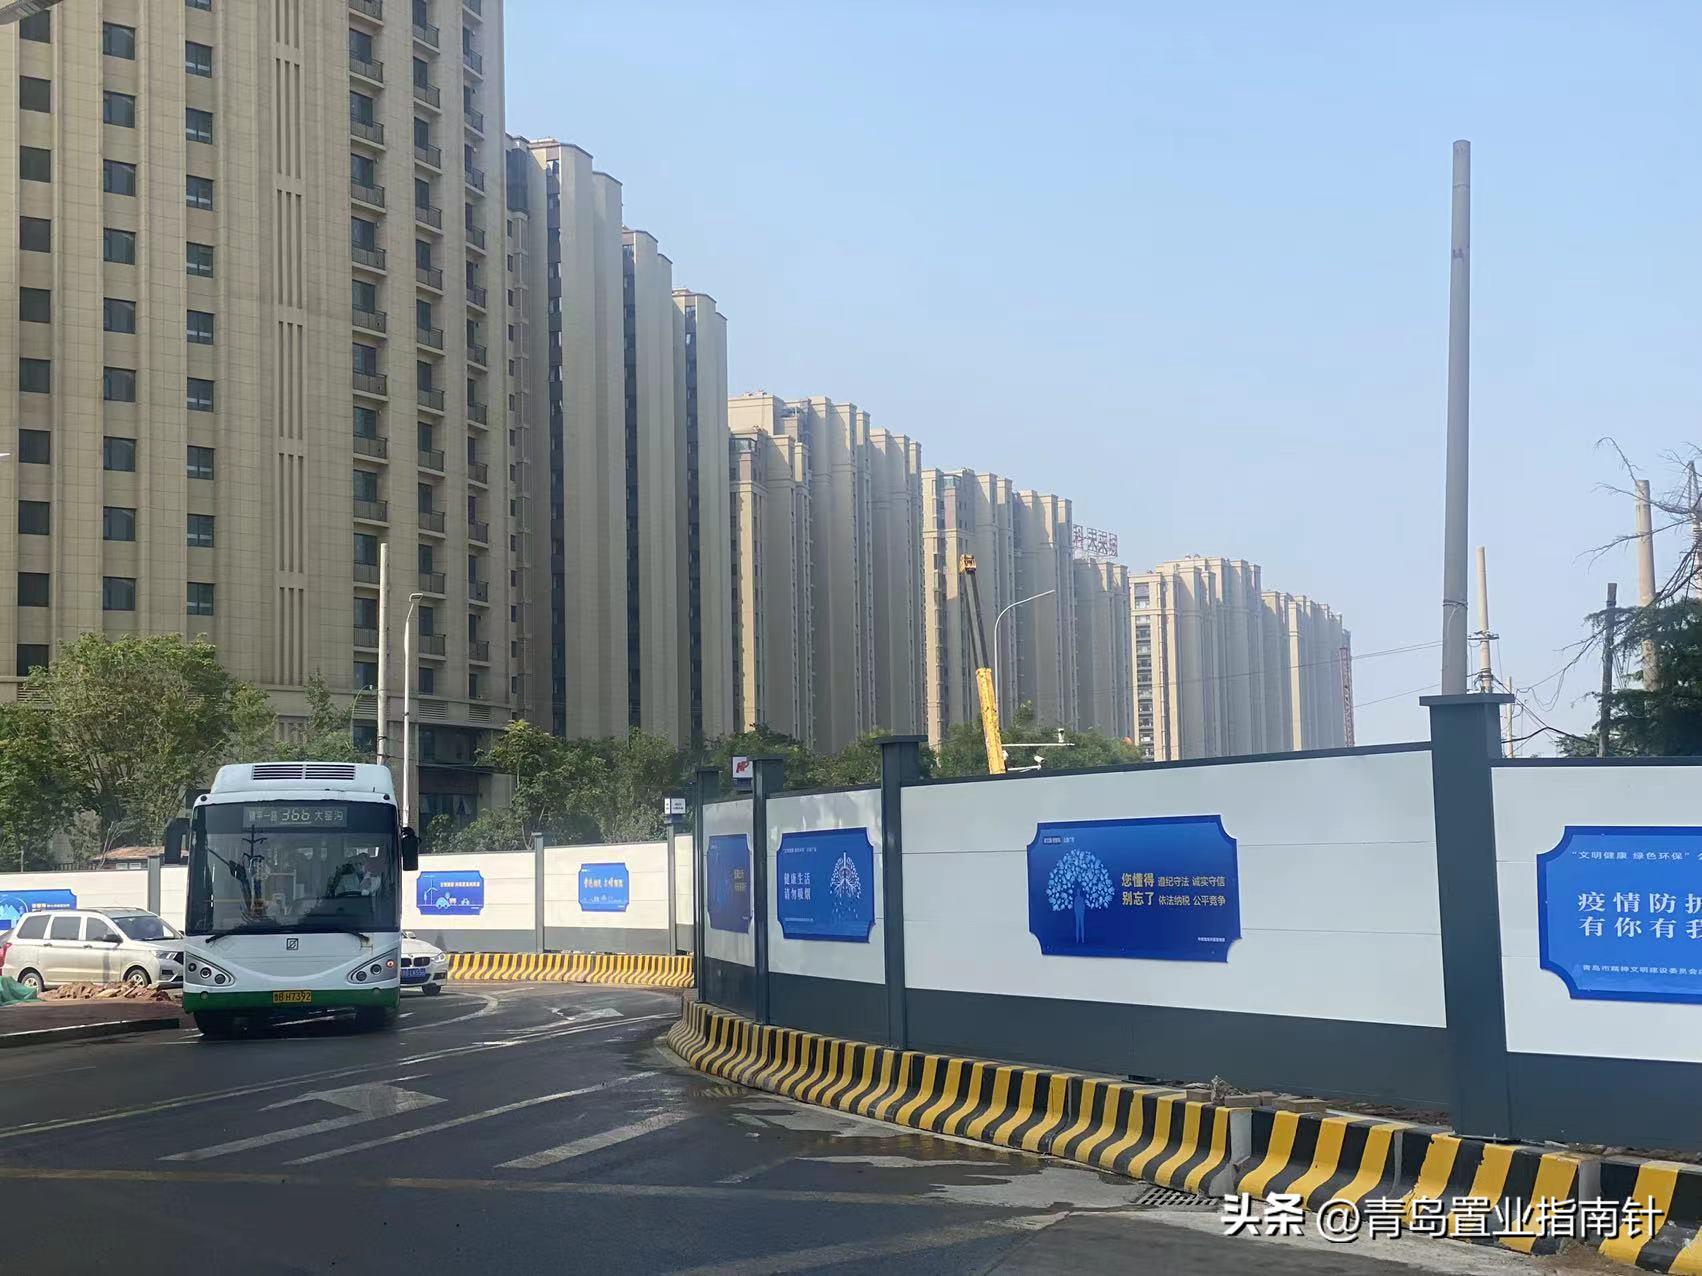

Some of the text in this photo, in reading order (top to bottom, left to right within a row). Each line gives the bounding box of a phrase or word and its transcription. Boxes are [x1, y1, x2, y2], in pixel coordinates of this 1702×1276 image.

[281, 809, 311, 822] 366
[783, 872, 811, 886] 健康生活
[784, 887, 811, 901] 请勿吸烟
[1121, 891, 1155, 906] 别忘了
[1193, 895, 1226, 907] 公平竞争
[1577, 891, 1702, 914] 疫情防护
[1578, 916, 1702, 939] 有你有我
